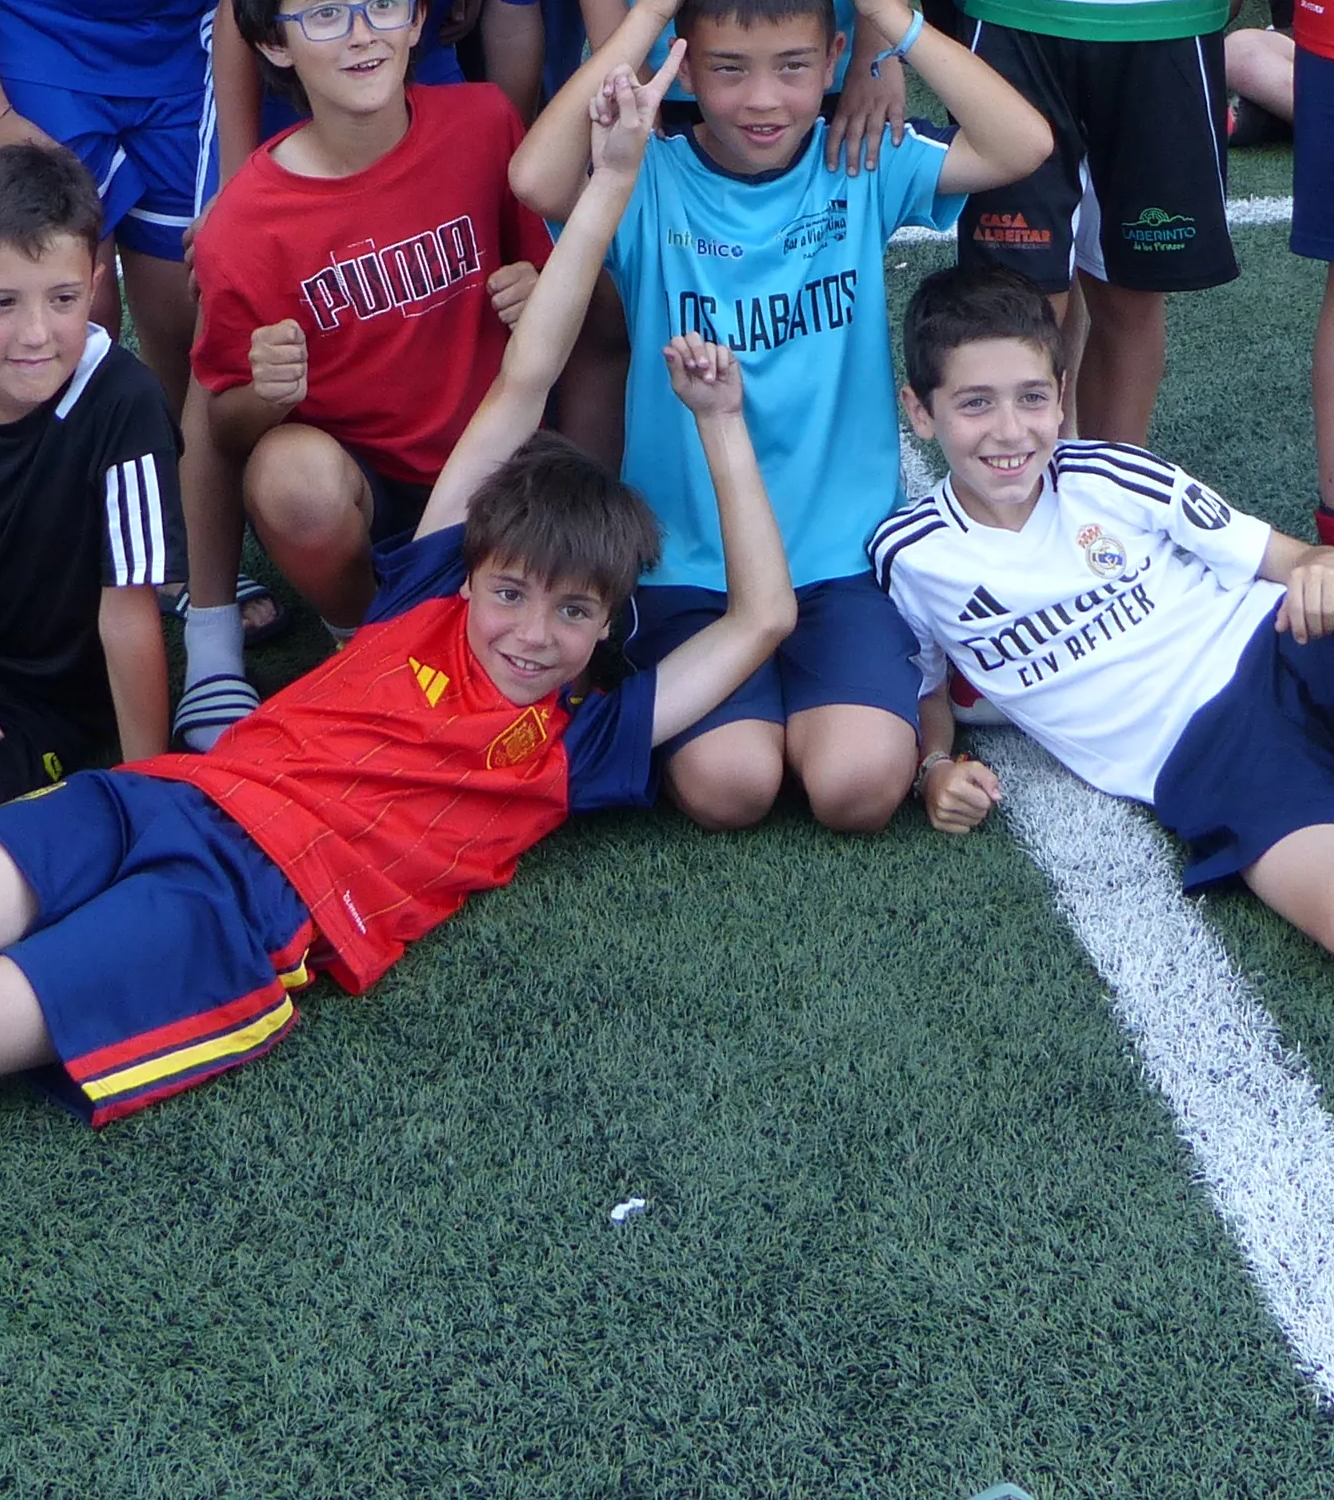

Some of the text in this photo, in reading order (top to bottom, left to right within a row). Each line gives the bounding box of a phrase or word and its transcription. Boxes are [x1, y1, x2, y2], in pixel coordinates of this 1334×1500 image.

[979, 211, 1028, 228] CASA
[973, 227, 1051, 243] ALBEITAR
[1122, 226, 1196, 243] LABERINTO
[300, 214, 481, 332] PUMA
[727, 268, 858, 353] JABATOS
